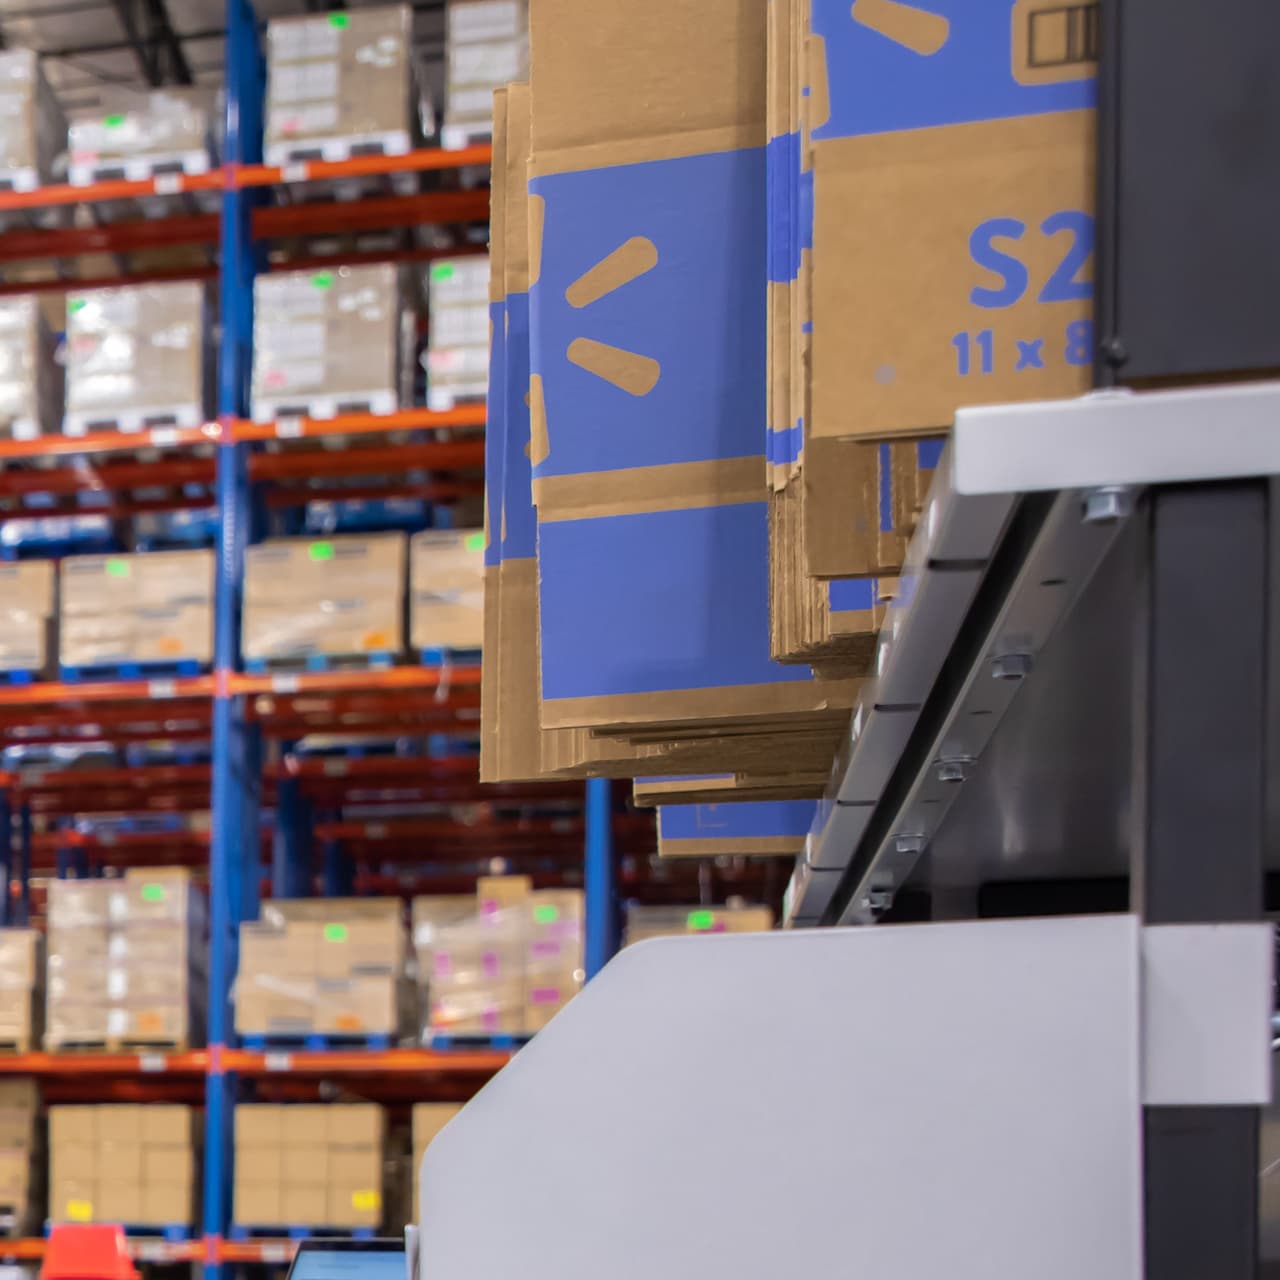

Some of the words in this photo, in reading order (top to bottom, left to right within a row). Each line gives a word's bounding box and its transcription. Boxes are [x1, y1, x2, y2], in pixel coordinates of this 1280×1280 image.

[969, 210, 1094, 309] S2
[951, 328, 993, 376] 11
[1015, 337, 1045, 372] x
